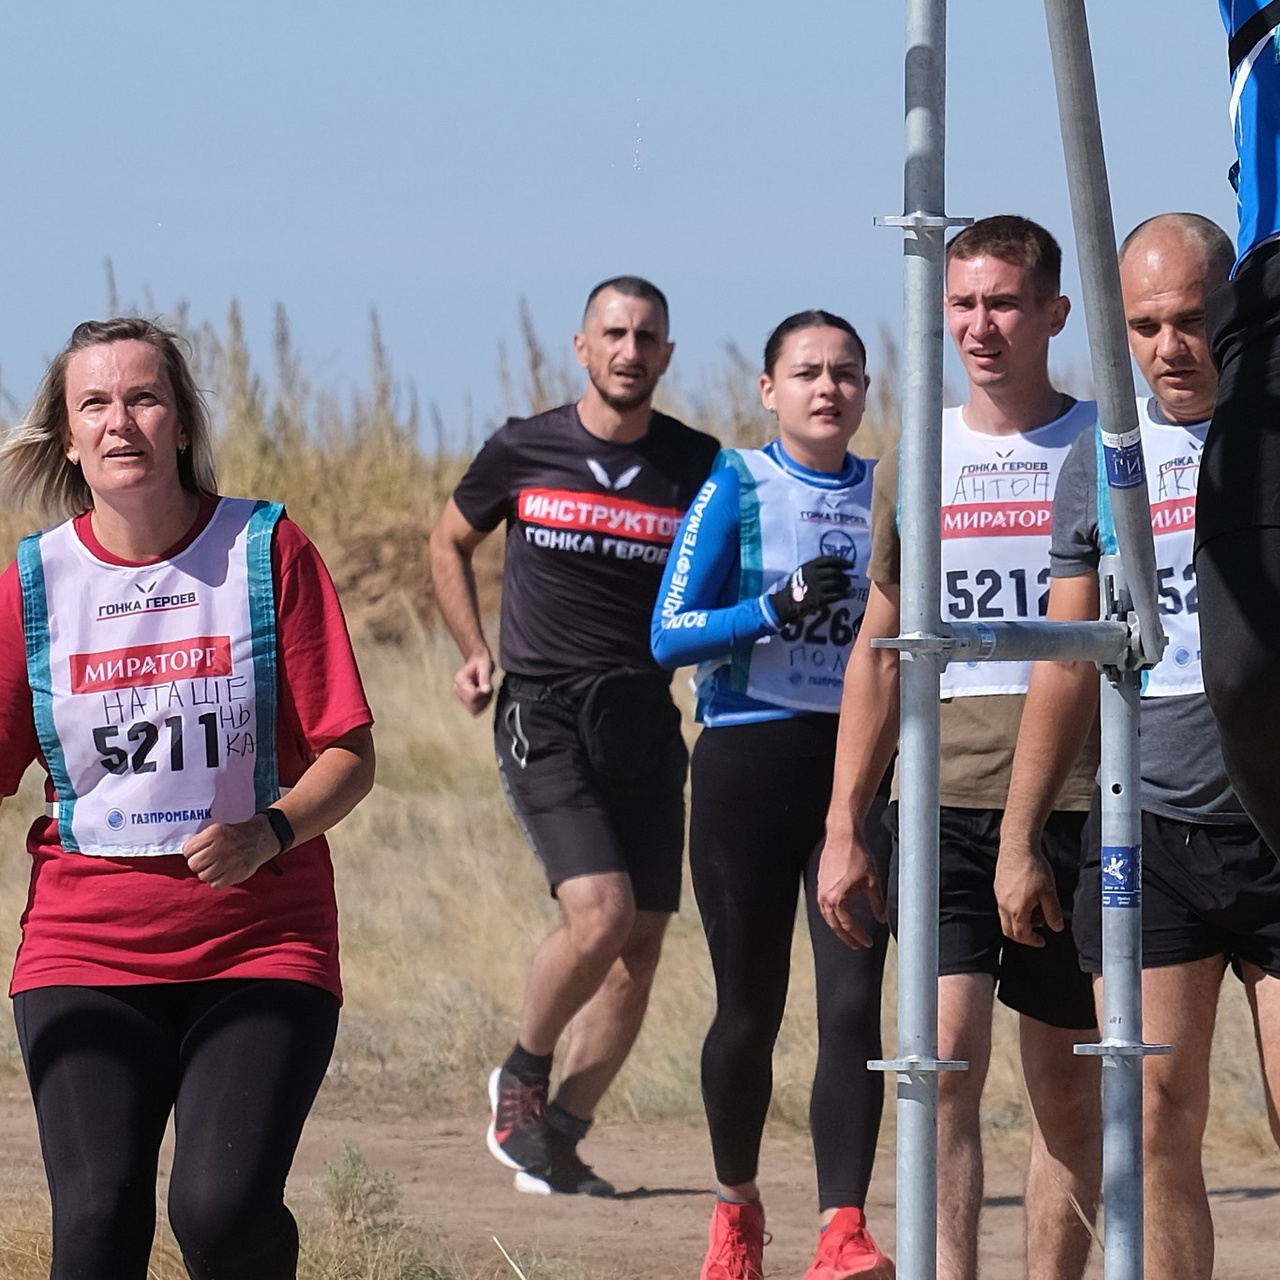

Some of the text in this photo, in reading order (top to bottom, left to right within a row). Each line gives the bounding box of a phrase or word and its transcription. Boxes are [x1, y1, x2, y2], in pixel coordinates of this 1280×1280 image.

[961, 461, 1049, 475] ГОНКА ГЕРОЕВ
[1158, 455, 1195, 472] ГОНКА
[952, 474, 1050, 507] АНТОН
[943, 509, 1051, 531] МИРАТОР
[525, 526, 670, 566] ГОНКА ГЕРОЕ
[1157, 563, 1199, 615] 52
[98, 591, 197, 617] ГОНКА ГЕРОЕВ
[84, 647, 217, 684] МИРАТОРГ
[789, 646, 845, 673] ПОЛ
[92, 712, 220, 776] 5211
[131, 806, 212, 825] ГАЗПРОМБАНК
